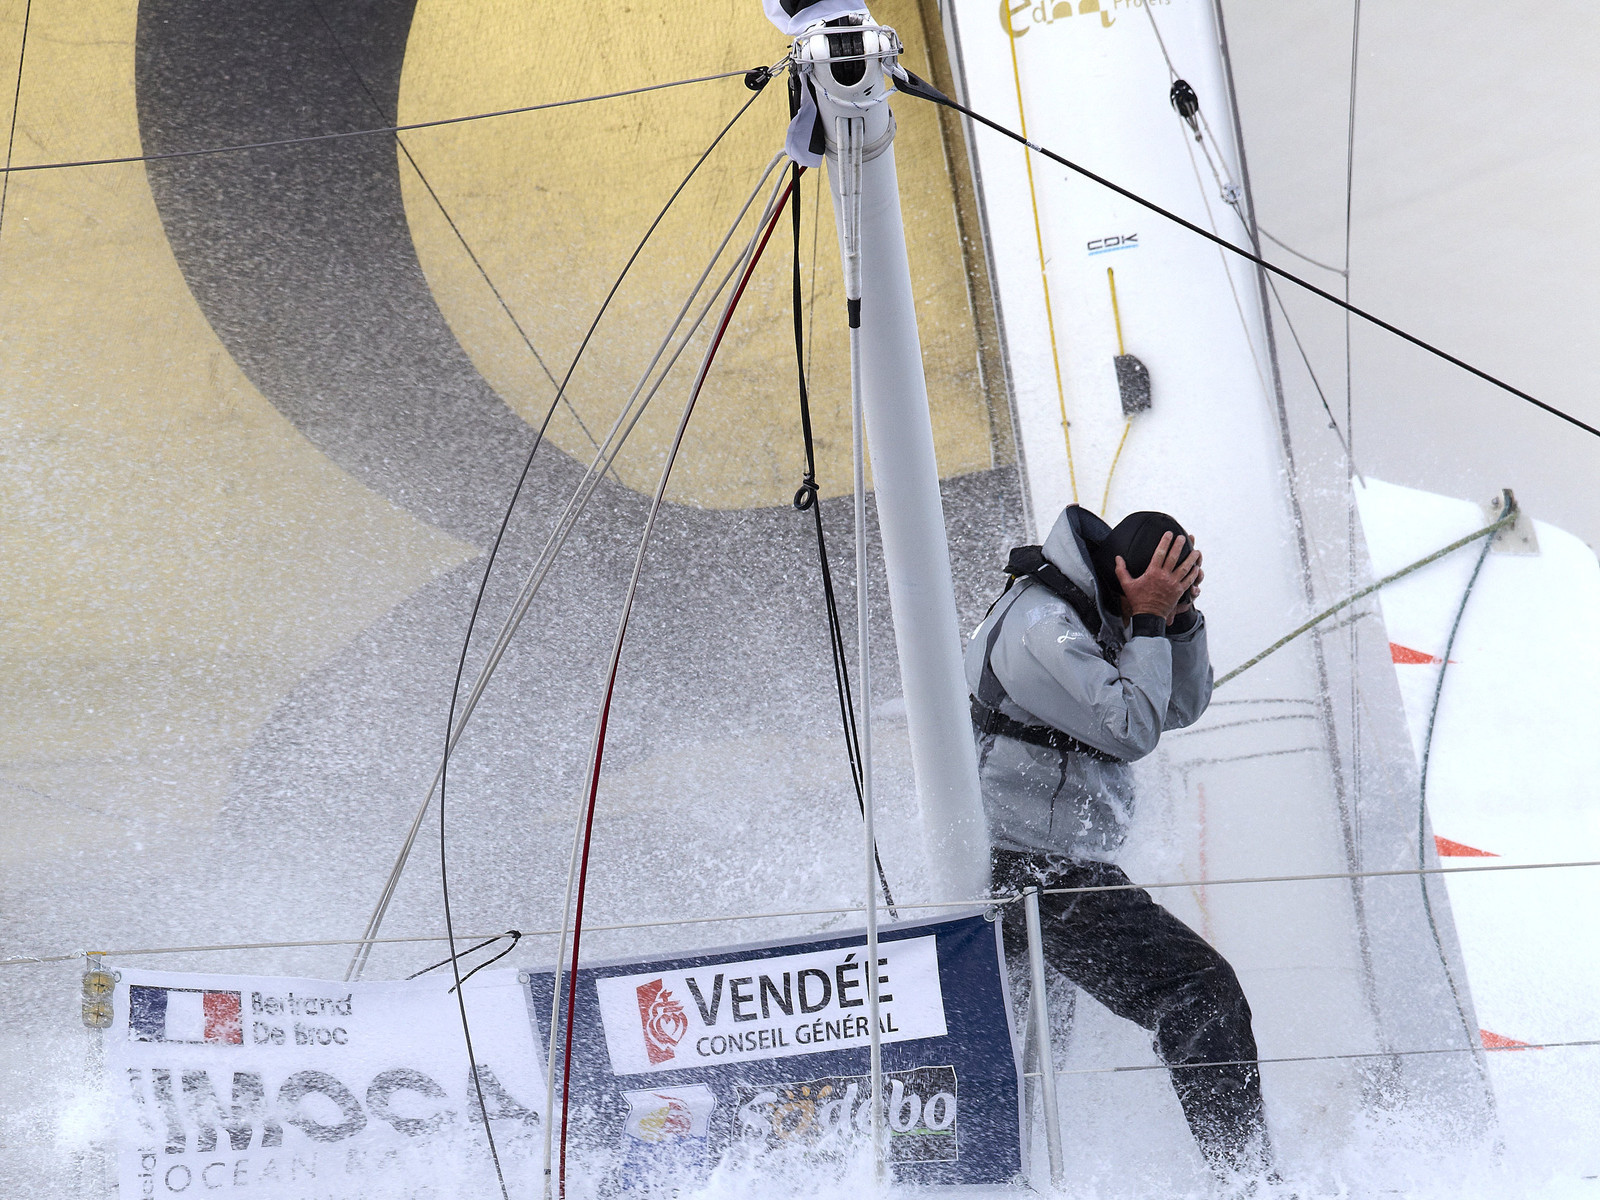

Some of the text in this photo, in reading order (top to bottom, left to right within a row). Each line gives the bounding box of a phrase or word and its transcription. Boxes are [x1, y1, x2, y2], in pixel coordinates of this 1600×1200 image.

[1087, 233, 1138, 250] CDK
[251, 991, 352, 1016] Bertrand
[685, 953, 893, 1027] VENDÉE
[252, 1021, 348, 1045] De Broc
[696, 1027, 789, 1057] CONSEIL
[164, 1152, 317, 1193] OCEAN
